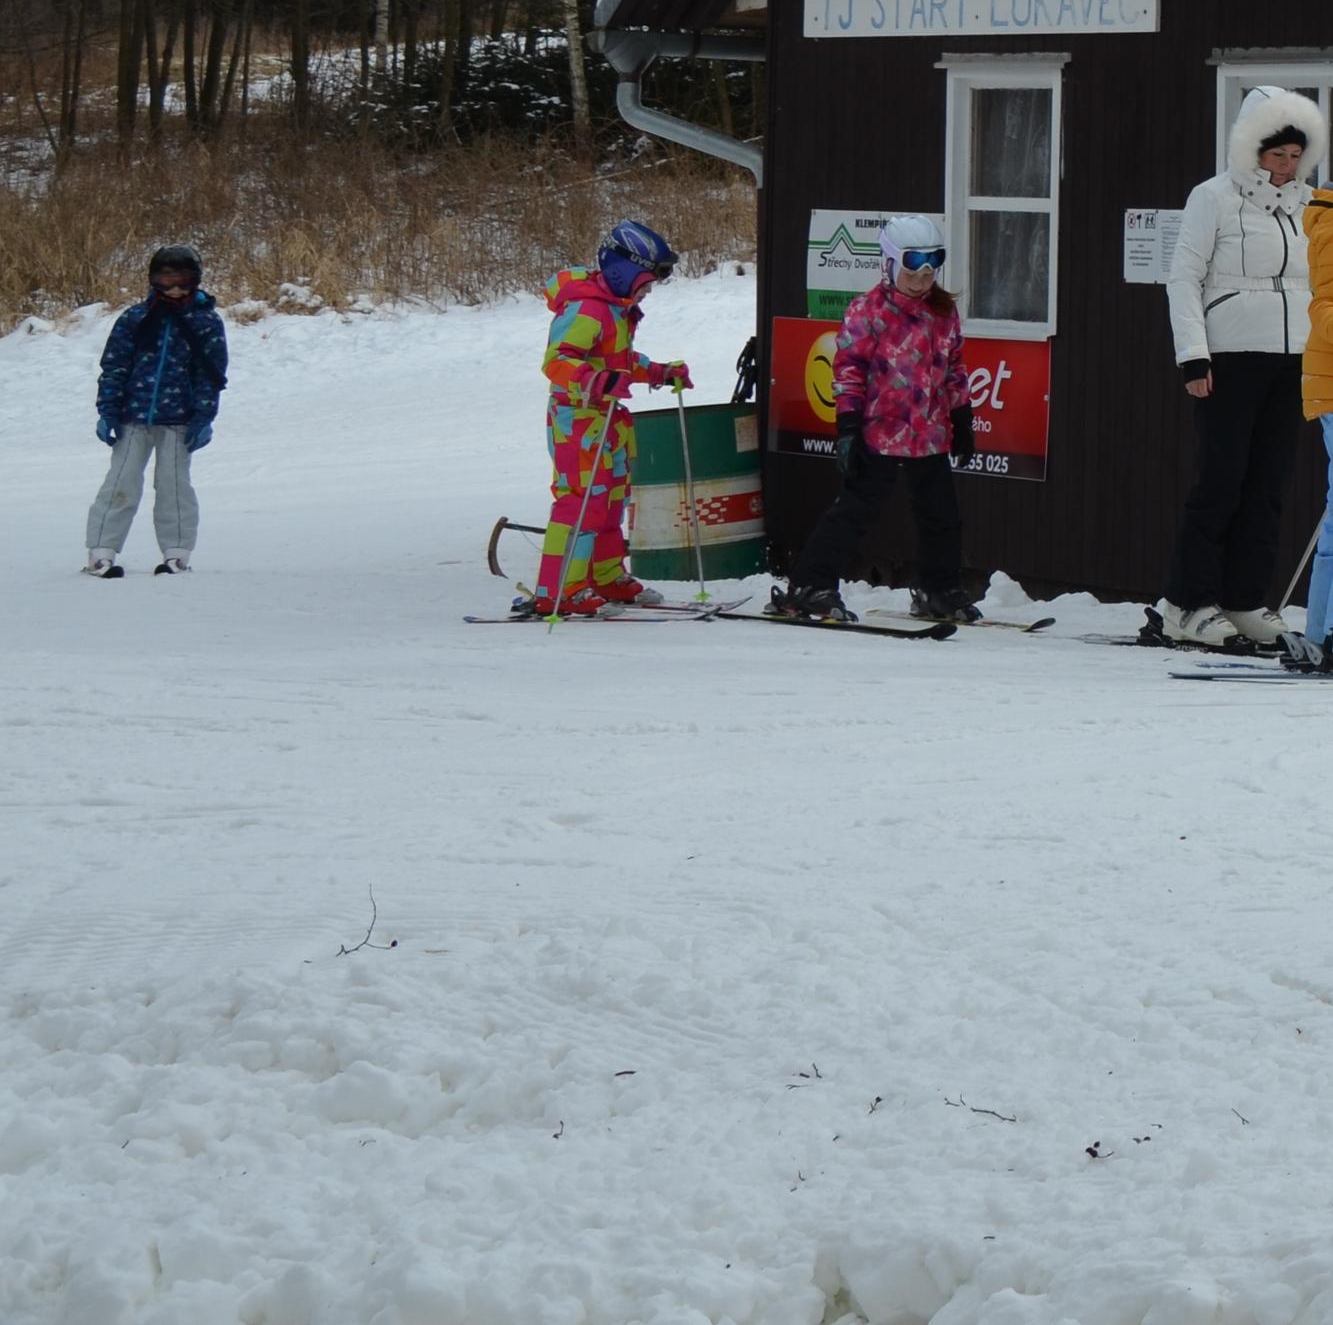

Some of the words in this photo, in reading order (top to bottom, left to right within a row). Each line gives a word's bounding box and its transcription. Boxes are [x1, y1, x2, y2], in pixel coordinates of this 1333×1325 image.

[967, 360, 1013, 410] et
[972, 414, 992, 434] ého
[803, 438, 838, 455] www.
[986, 454, 1009, 474] 025
